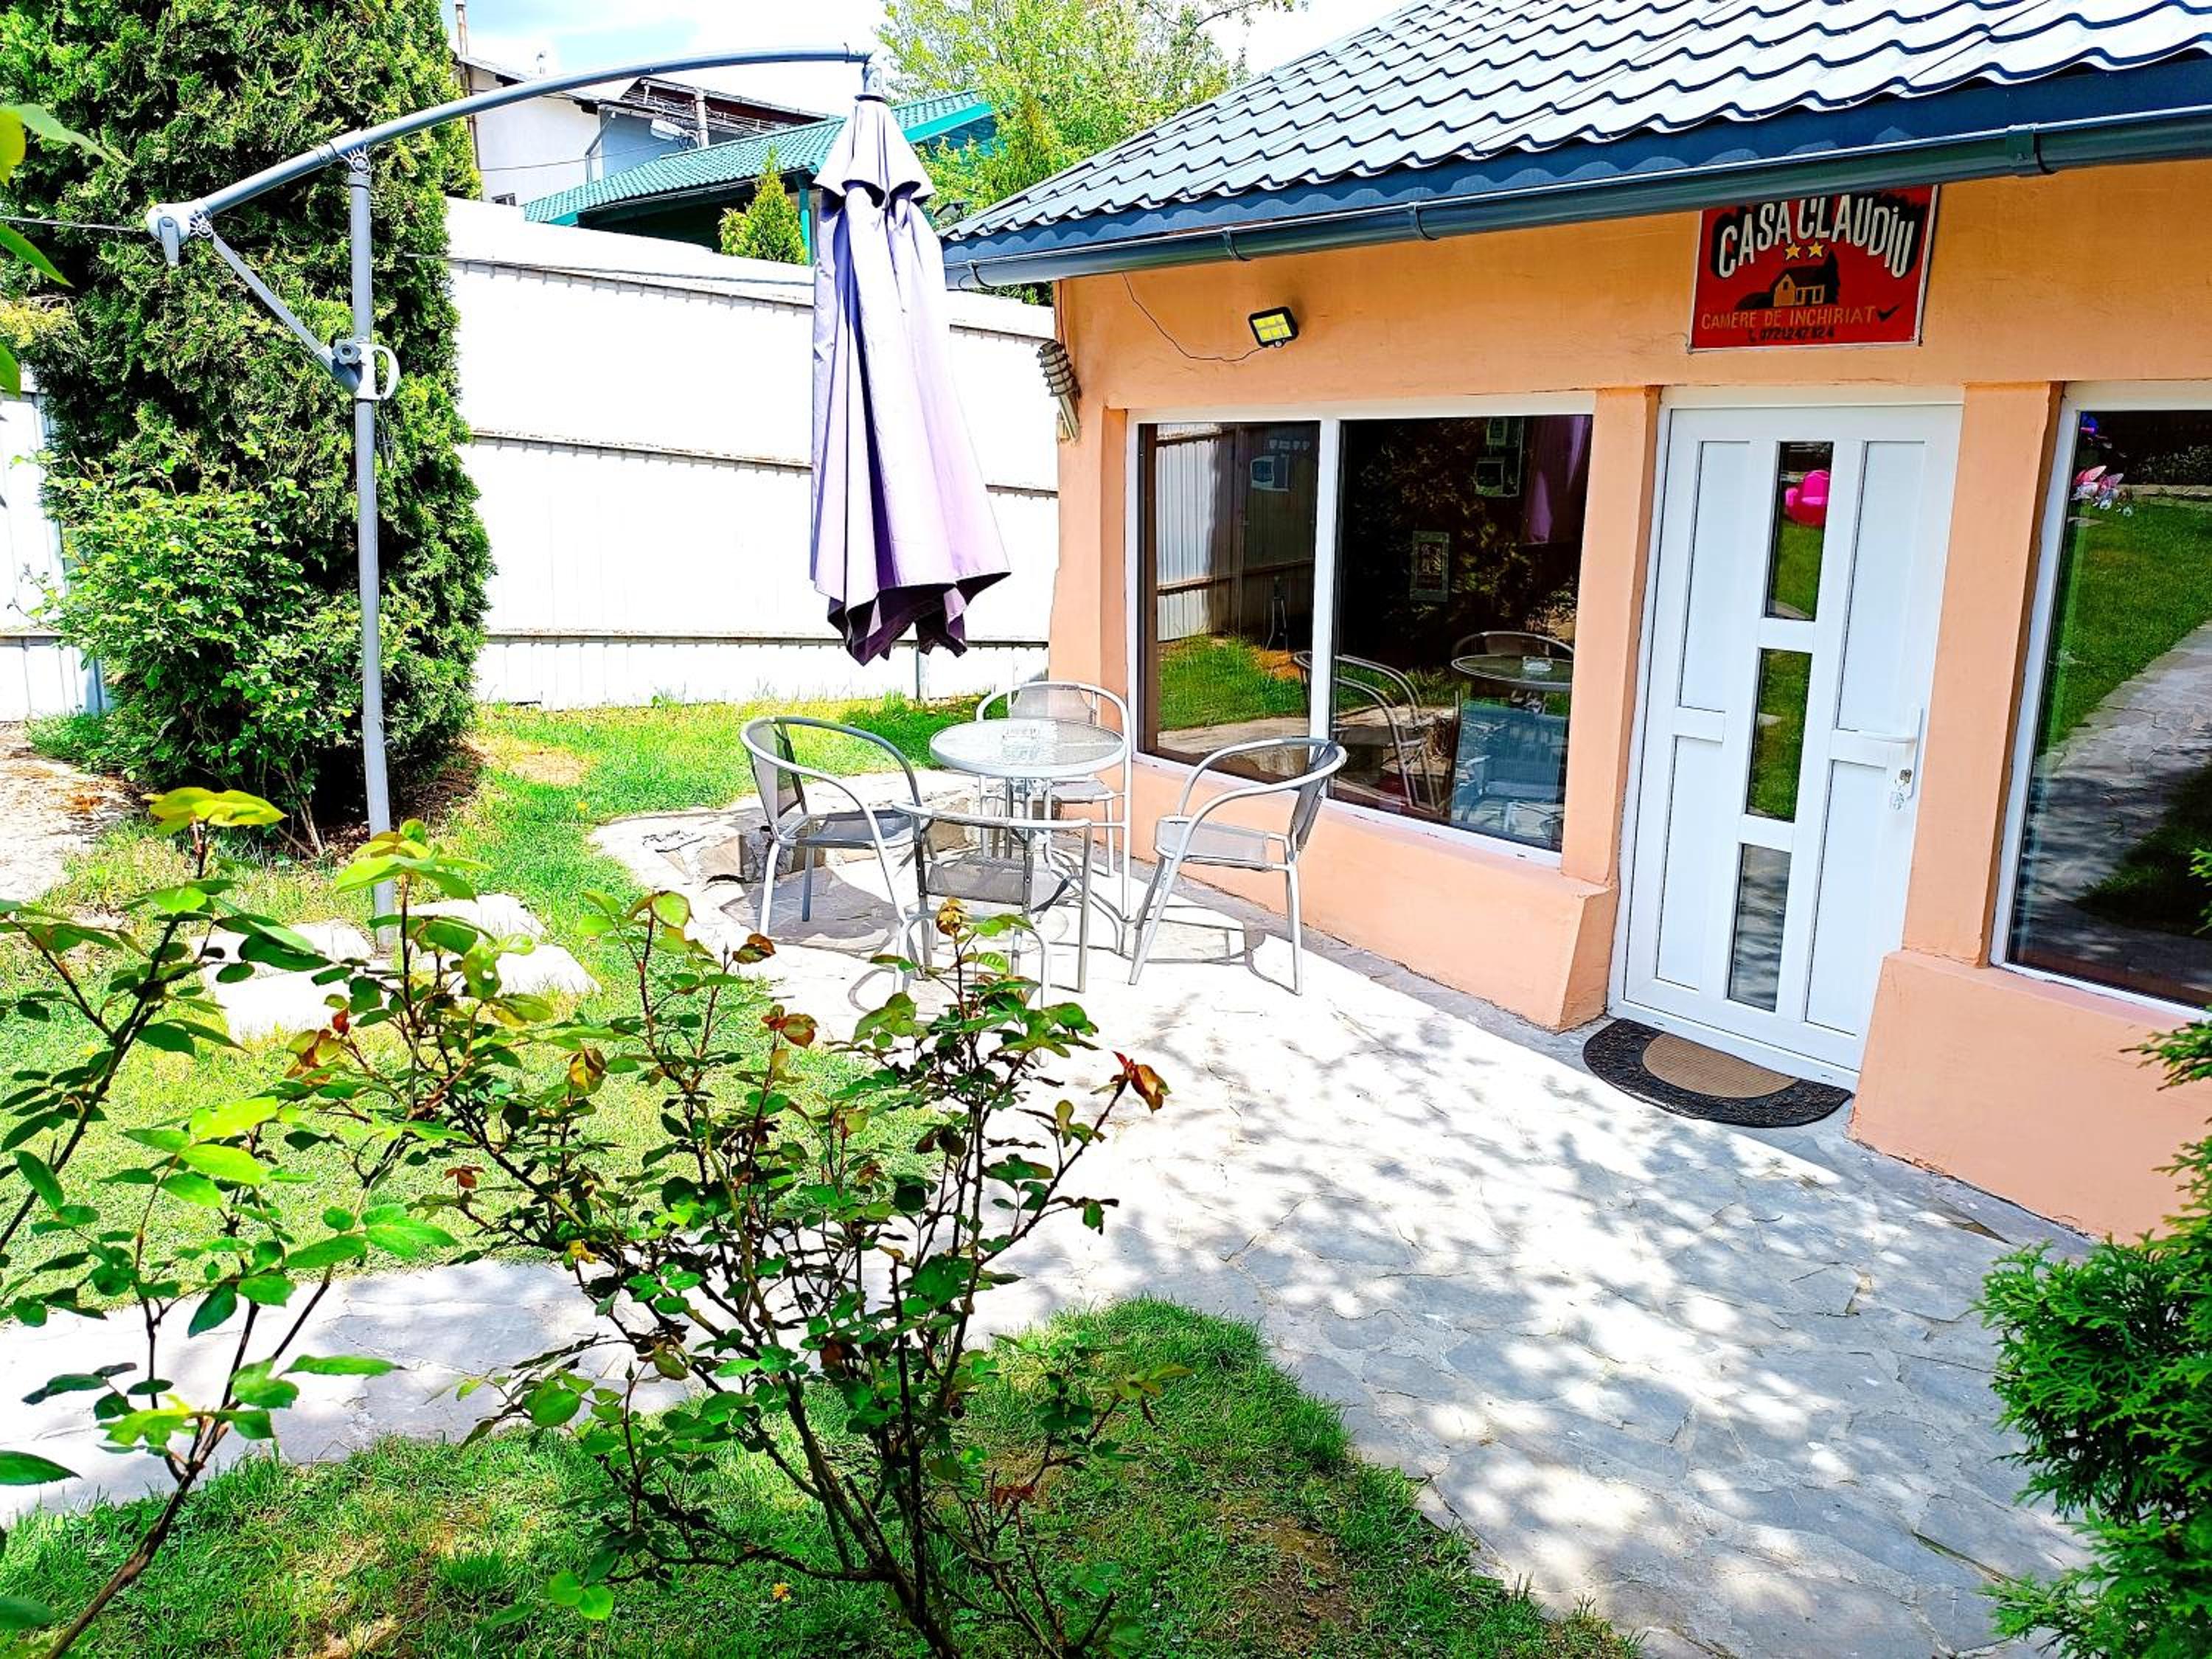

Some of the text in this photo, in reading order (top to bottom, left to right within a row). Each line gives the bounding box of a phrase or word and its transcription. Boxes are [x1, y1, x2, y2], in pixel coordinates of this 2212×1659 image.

[1719, 201, 1792, 278] CASA
[1701, 306, 1876, 330] CAMERE DE INCHIRIAT
